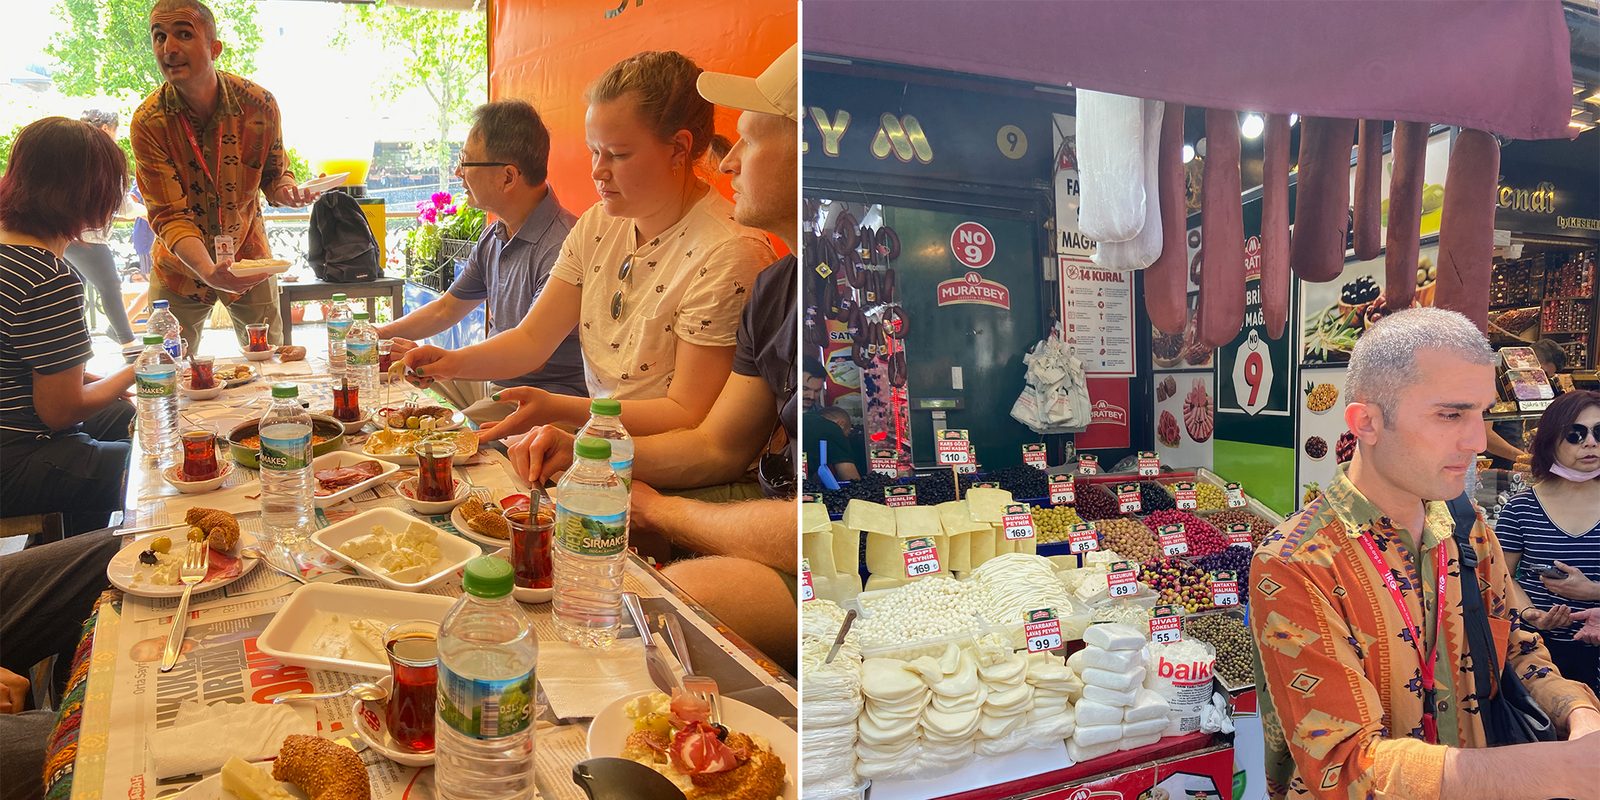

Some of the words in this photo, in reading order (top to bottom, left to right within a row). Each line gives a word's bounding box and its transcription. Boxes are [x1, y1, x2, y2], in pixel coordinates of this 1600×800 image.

[802, 106, 851, 157] Y
[1006, 131, 1018, 153] 9
[1066, 178, 1080, 195] FA
[1498, 181, 1556, 214] endi
[959, 232, 986, 245] NO
[965, 247, 982, 264] 9
[1079, 270, 1091, 281] 14
[1092, 271, 1125, 283] KURAL
[941, 285, 1005, 300] MURATBEY
[830, 331, 851, 340] SAT
[1249, 334, 1257, 344] NO
[1243, 351, 1264, 407] 9
[945, 453, 960, 462] 110
[1011, 529, 1026, 538] 169
[581, 535, 626, 549] SIRMAKE
[1079, 542, 1090, 551] 85
[908, 549, 933, 557] TOPİ
[1169, 547, 1180, 555] 65
[907, 554, 935, 563] PEYNİR
[913, 563, 930, 573] 169
[1116, 586, 1128, 595] 89
[1221, 597, 1231, 605] 45
[1151, 617, 1178, 625] SİVAS
[1157, 633, 1170, 643] 55
[1035, 639, 1050, 650] 99
[129, 774, 144, 800] ABAH
